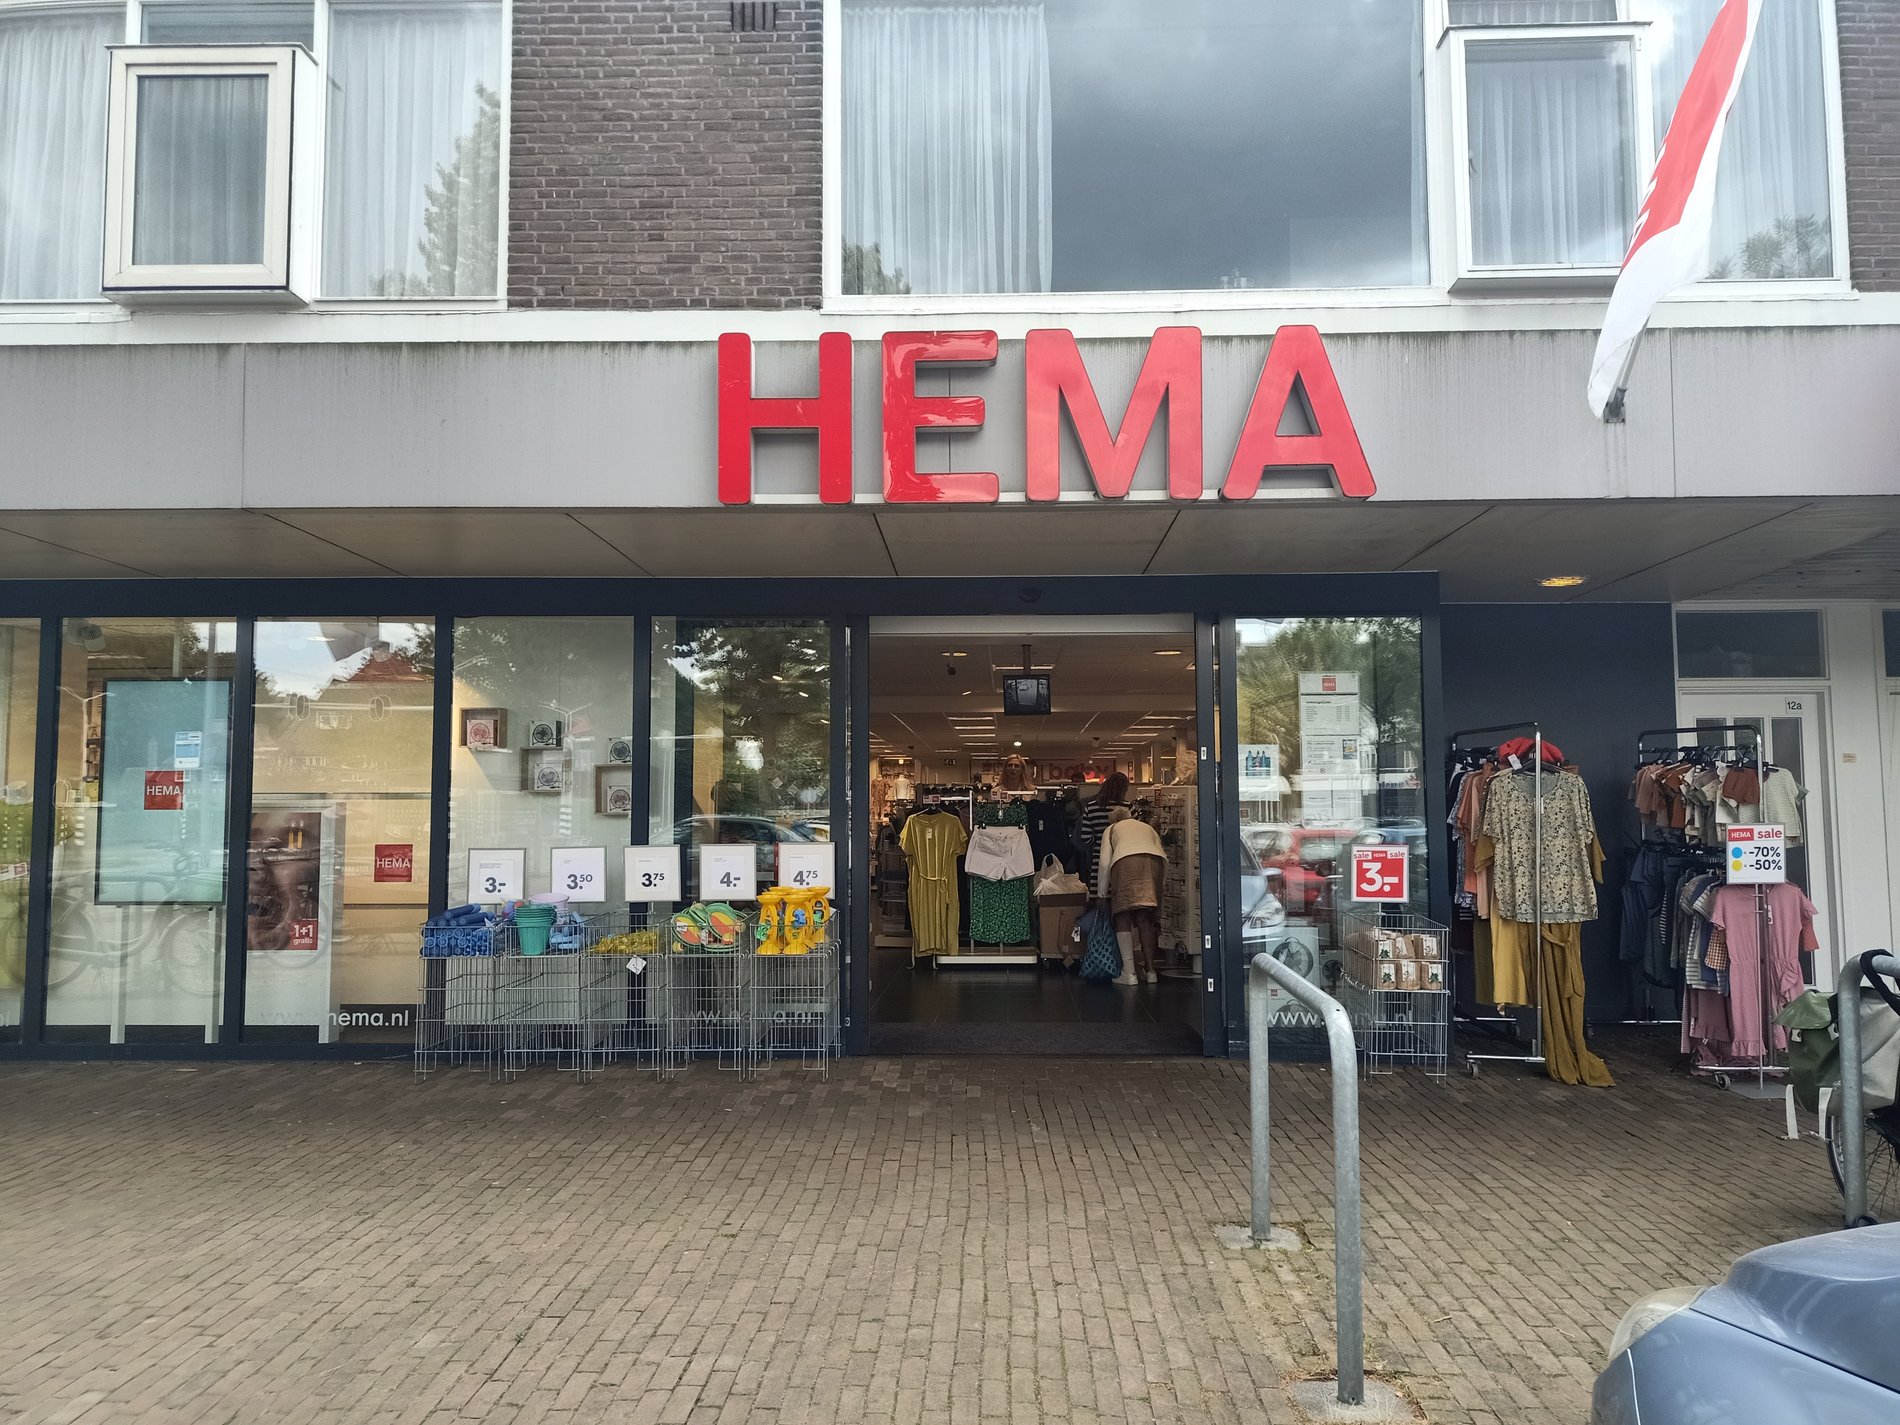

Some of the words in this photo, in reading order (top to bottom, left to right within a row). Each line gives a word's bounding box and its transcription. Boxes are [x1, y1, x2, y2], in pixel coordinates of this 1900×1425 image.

[717, 324, 1377, 504] HEMA
[1787, 701, 1803, 710] 12a
[146, 785, 181, 796] HEMA
[1757, 828, 1783, 839] sale
[1748, 846, 1781, 858] -70%
[376, 857, 411, 869] HEMA
[1748, 859, 1783, 871] -50%
[293, 924, 314, 938] 1+1
[293, 937, 313, 946] gratis
